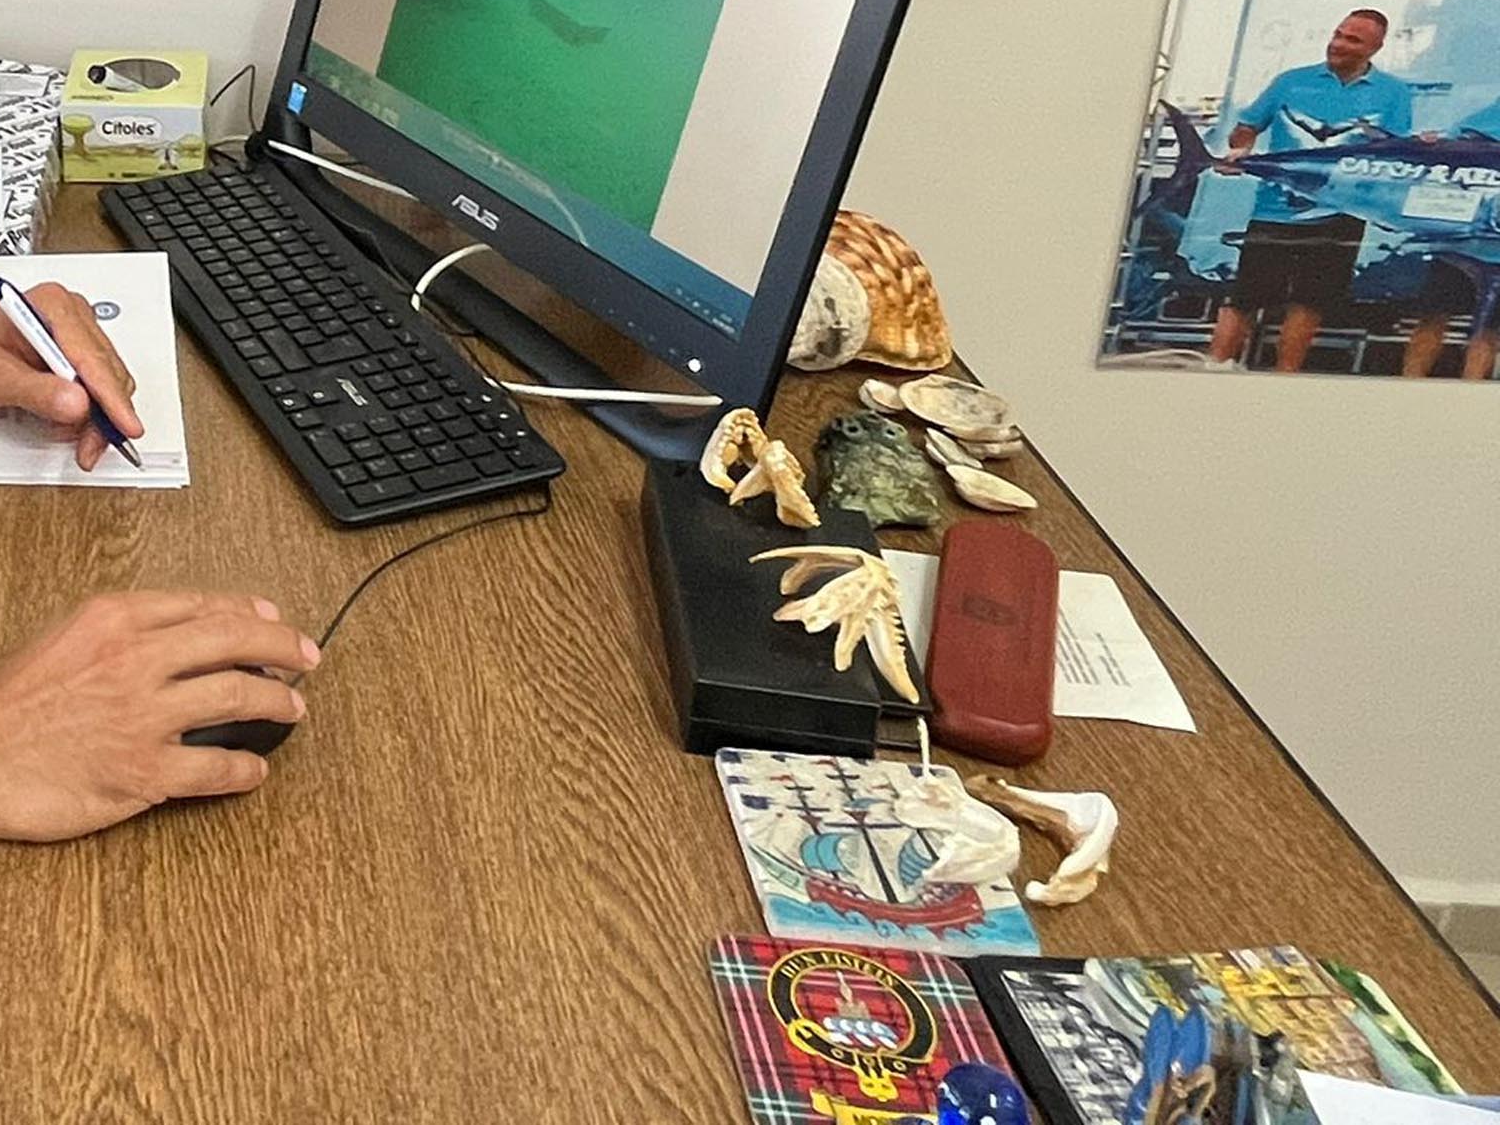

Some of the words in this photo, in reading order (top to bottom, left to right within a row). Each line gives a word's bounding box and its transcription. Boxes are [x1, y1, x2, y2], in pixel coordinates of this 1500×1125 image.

[101, 120, 155, 136] Citoles
[1338, 156, 1427, 179] CATCH
[450, 193, 501, 232] ASUS
[334, 376, 369, 407] ASUS
